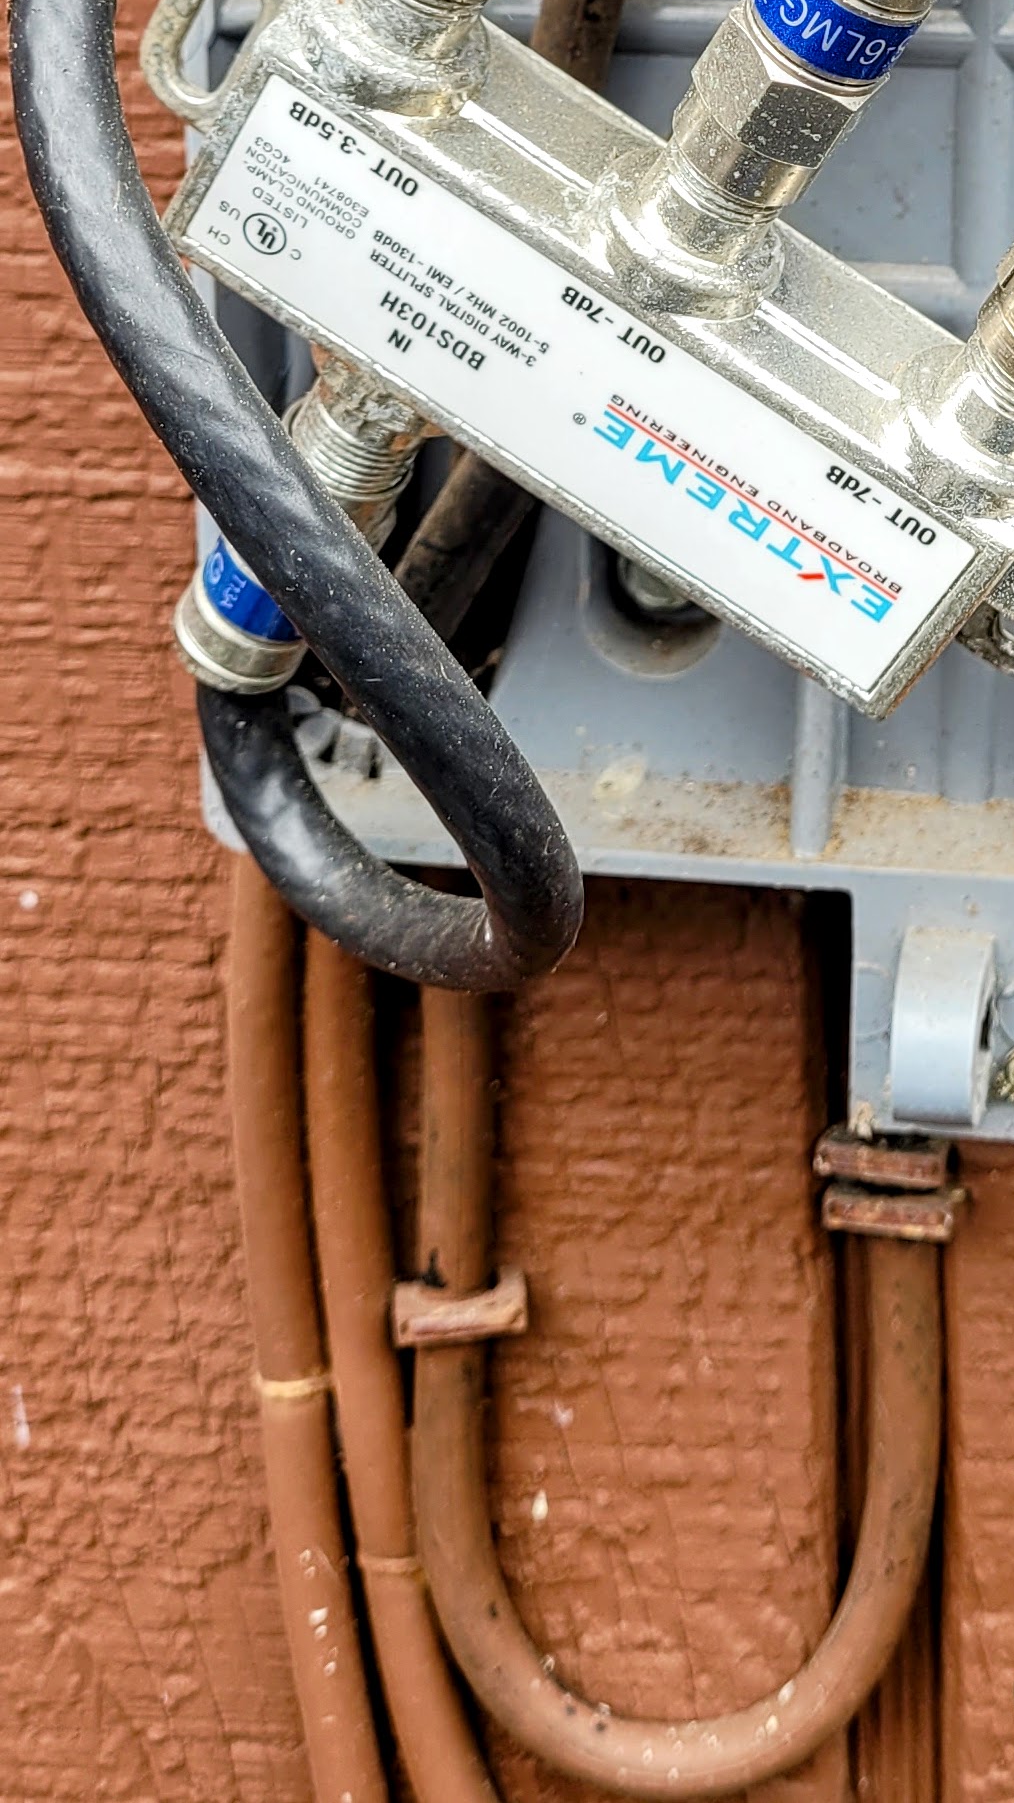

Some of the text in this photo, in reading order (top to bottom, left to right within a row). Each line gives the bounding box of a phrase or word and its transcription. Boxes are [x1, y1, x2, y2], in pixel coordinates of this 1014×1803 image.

[254, 136, 369, 218] E308741 4CG3
[289, 101, 419, 197] OUT -3.5dB
[218, 200, 241, 221] US
[246, 146, 363, 229] COMMUNICATION
[251, 186, 309, 229] LISTED
[296, 196, 356, 240] GROUND
[207, 225, 231, 246] CH
[373, 229, 423, 265] -130dB
[369, 249, 537, 367] 3-WAY DIGITAL SPLITTER
[426, 265, 454, 290] EMI
[466, 291, 497, 319] MHz
[380, 291, 486, 371] BDS103H
[387, 329, 412, 353] IN
[498, 314, 550, 355] 5-1002
[561, 286, 666, 364] OUT -7dB
[593, 410, 894, 623] EXTREME
[610, 394, 903, 594] BROADBAND ENGINEERING
[825, 465, 937, 546] OUT -7dB
